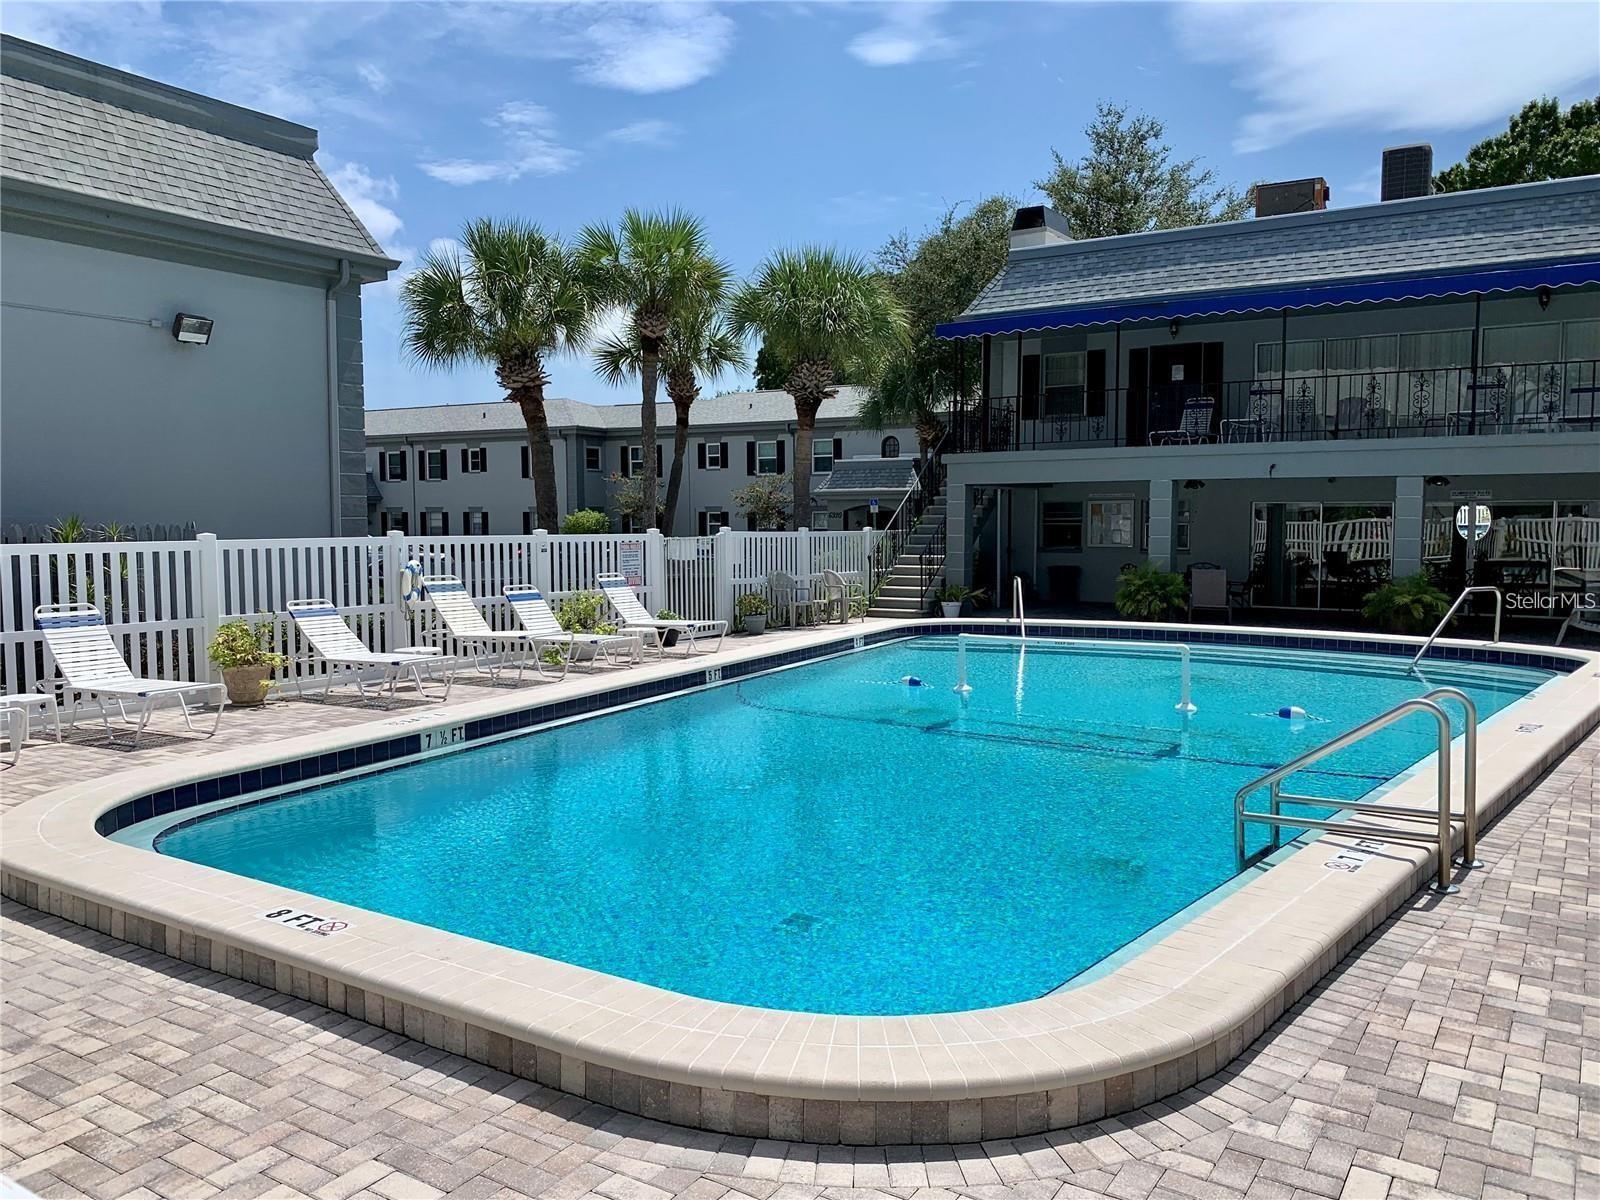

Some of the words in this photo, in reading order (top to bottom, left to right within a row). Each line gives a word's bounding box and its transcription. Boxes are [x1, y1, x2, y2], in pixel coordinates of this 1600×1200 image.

[708, 671, 713, 681] 5
[426, 733, 432, 749] 7
[265, 909, 293, 919] 8
